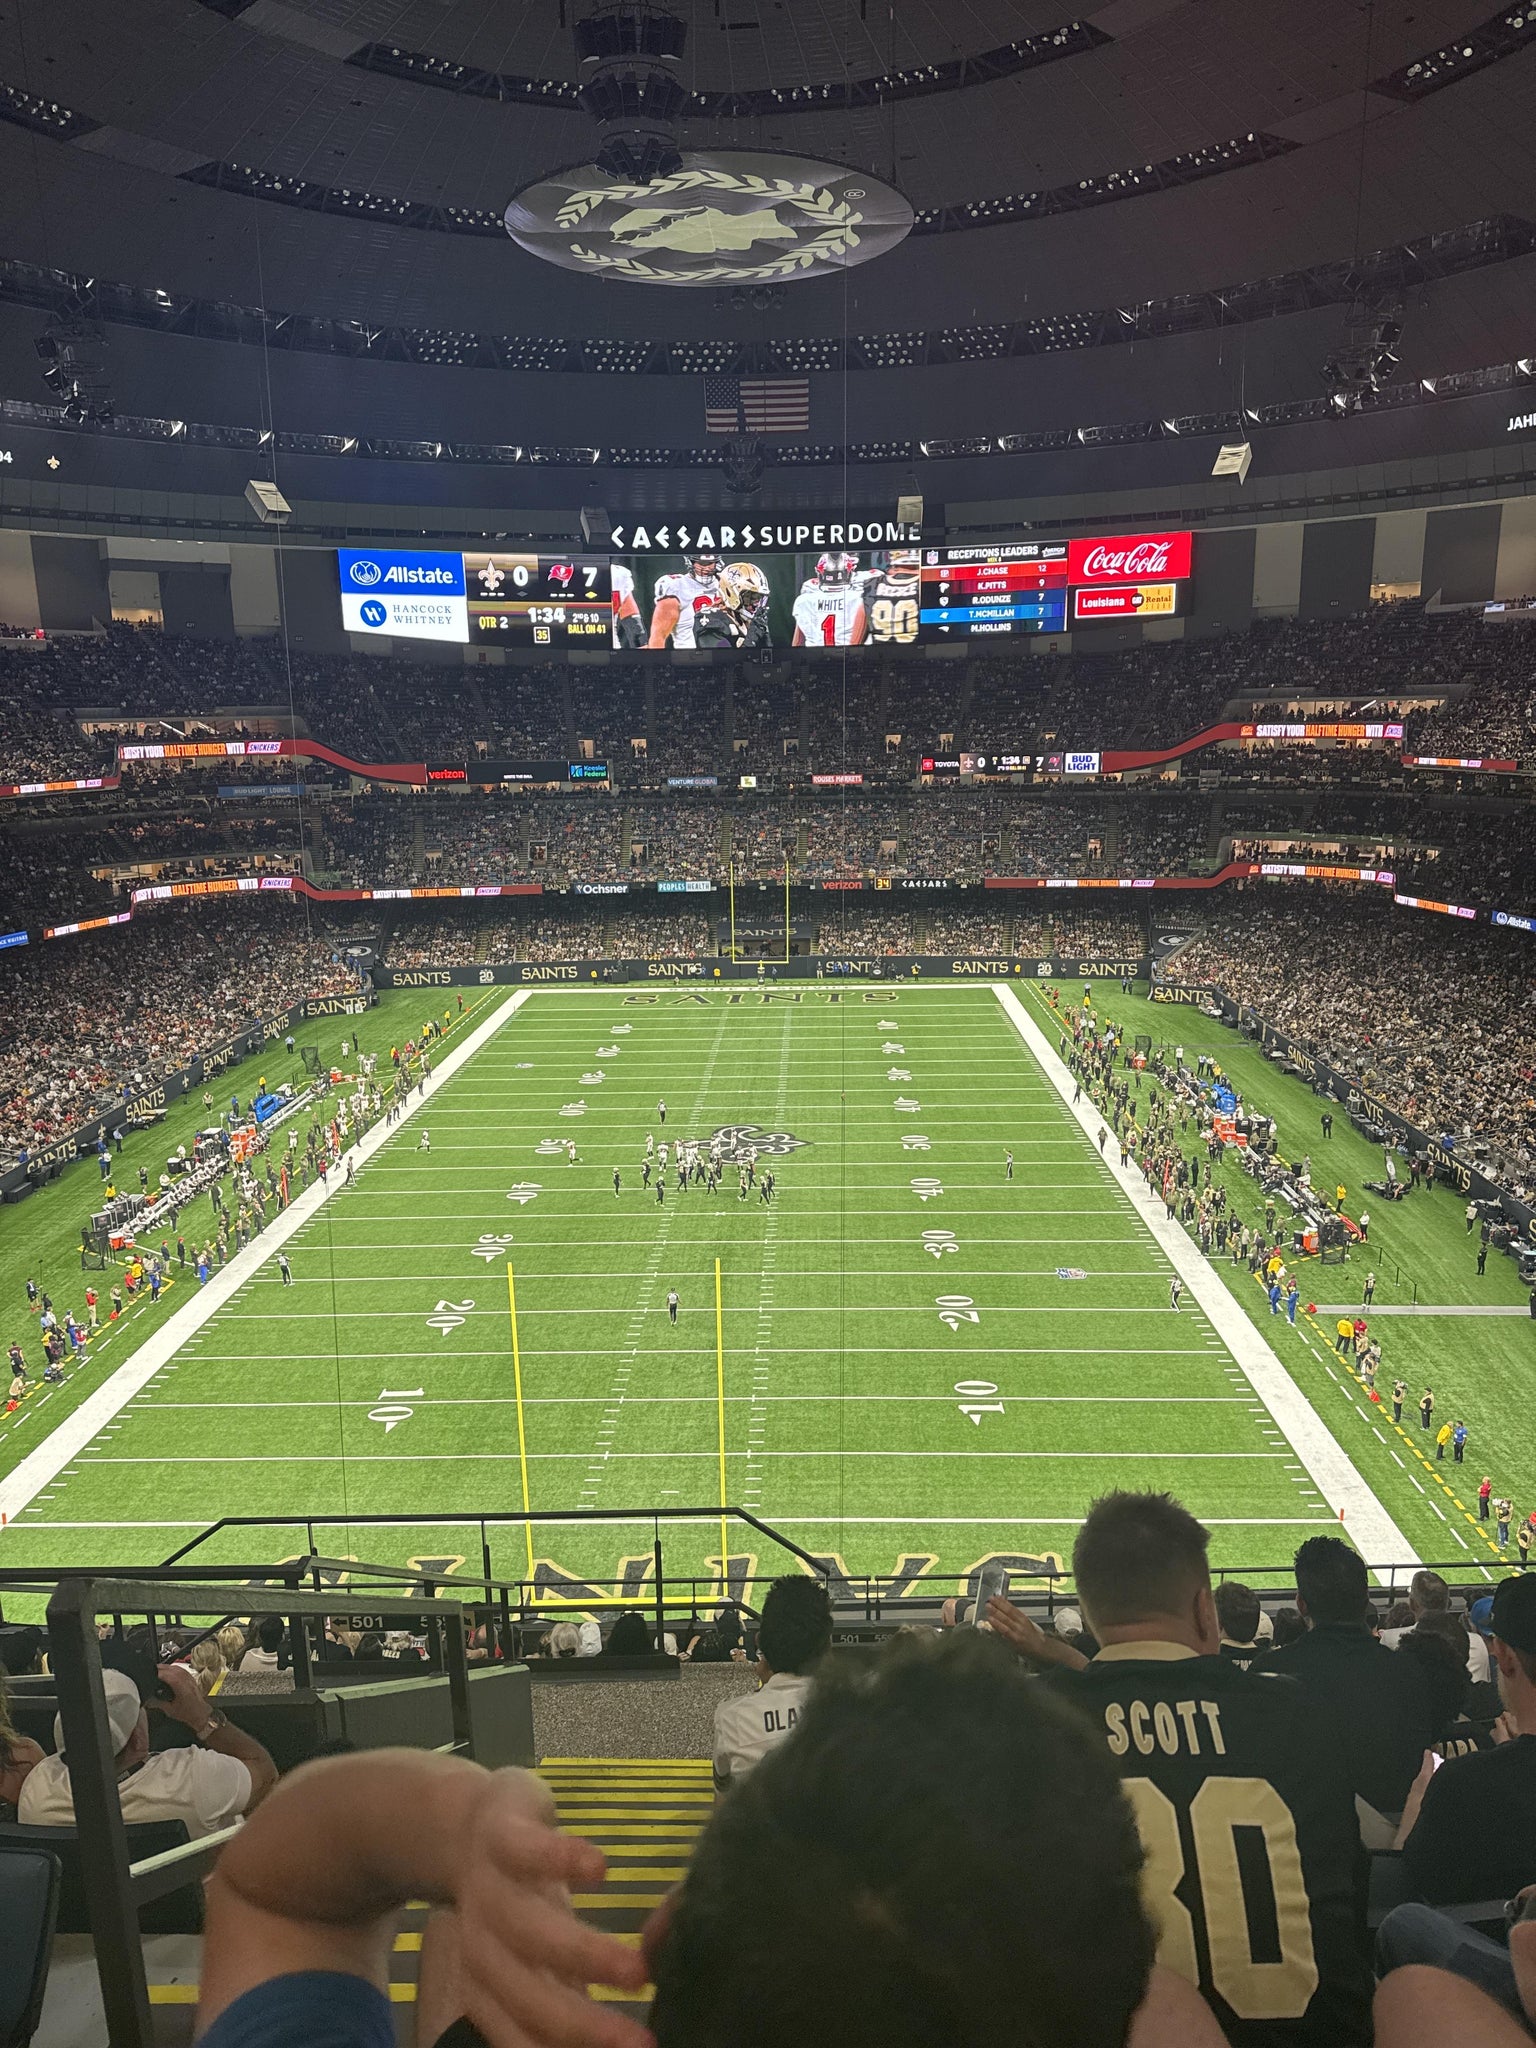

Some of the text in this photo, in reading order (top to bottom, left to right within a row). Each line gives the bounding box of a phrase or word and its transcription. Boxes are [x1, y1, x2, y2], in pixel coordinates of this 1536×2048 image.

[611, 522, 921, 549] CAESARS SUPERDOME
[947, 547, 1000, 560] RECEPTIONS
[1001, 546, 1039, 557] LEADERS
[1083, 541, 1174, 577] Coca-Cola
[383, 566, 454, 585] Allstate
[513, 565, 529, 587] 0
[976, 564, 1047, 576] J.CHASE 12
[582, 567, 597, 588] 7
[977, 578, 1045, 590] K.PITTS 9
[817, 598, 844, 611] WHITE
[972, 593, 1045, 605] R.ODUNZE 7
[1082, 597, 1125, 608] Louisiana
[1146, 595, 1172, 603] Rental
[392, 604, 451, 616] HANCOCK
[527, 606, 566, 623] 1:34
[968, 607, 1044, 618] T.MCMILLAN 7
[394, 615, 453, 626] WHITNEY
[479, 616, 509, 630] QTR 2
[970, 621, 1044, 633] M.HOLLINS 7
[536, 630, 548, 641] 35
[567, 623, 606, 635] BALL ON 41
[821, 614, 836, 646] 1
[1256, 724, 1286, 737] SATISFY
[1286, 724, 1305, 736] YOUR
[1305, 724, 1337, 736] HALFTIME
[1337, 724, 1365, 737] HUNGER
[1365, 724, 1384, 738] WITH
[145, 745, 165, 758] YOUR
[164, 744, 198, 757] HALFTIME
[198, 742, 227, 756] HUNGER
[226, 742, 245, 755] WITH
[249, 743, 280, 752] SNICKERS
[977, 757, 986, 768] 0
[1036, 757, 1044, 768] 7
[1071, 755, 1094, 763] BUD
[1067, 763, 1097, 771] LIGHT
[428, 769, 465, 780] verizon
[158, 789, 186, 798] SAINTS
[269, 786, 291, 794] LOUNGE
[1261, 864, 1289, 875] SATISFY
[1288, 865, 1306, 876] YOUR
[1305, 866, 1336, 877] HALFTIME
[1335, 867, 1360, 879] HUNGER
[151, 885, 172, 899] YOUR
[172, 882, 207, 896] HALFTIME
[206, 880, 238, 894] HUNGER
[237, 878, 259, 890] WITH
[262, 878, 291, 887] SNICKERS
[544, 883, 571, 891] SAINTS
[583, 884, 628, 894] Ochsner
[659, 882, 710, 891] PEOPLES HEALTH
[821, 880, 863, 890] verizon
[876, 879, 890, 888] 34
[901, 879, 948, 888] CAESARS
[1507, 917, 1533, 930] Allstate
[733, 927, 798, 937] SAINTS
[521, 966, 578, 980] SAINTS
[648, 962, 703, 976] SAINTS
[952, 961, 1009, 975] SAINTS
[1037, 961, 1054, 975] 20
[1079, 963, 1138, 976] SAINTS
[393, 971, 451, 986] SAINTS
[479, 969, 495, 982] 20
[621, 991, 899, 1006] SAINTS
[1154, 986, 1213, 1002] SAINTS
[308, 996, 368, 1016] SAINTS
[263, 1013, 290, 1040] SAINTS
[1287, 1045, 1316, 1077] SAINTS
[126, 1085, 166, 1123] SAINTS
[535, 1138, 571, 1154] 50
[901, 1135, 931, 1150] 50
[506, 1181, 542, 1200] 40
[910, 1178, 943, 1196] 40
[471, 1234, 513, 1256] 30
[921, 1230, 959, 1253] 30
[425, 1299, 475, 1328] 20
[935, 1295, 980, 1324] 20
[954, 1380, 1005, 1414] 10
[367, 1387, 424, 1422] 10
[352, 1615, 384, 1629] 501
[840, 1634, 860, 1644] 501
[763, 1707, 799, 1733] OLA
[1105, 1699, 1226, 1756] SCOTT
